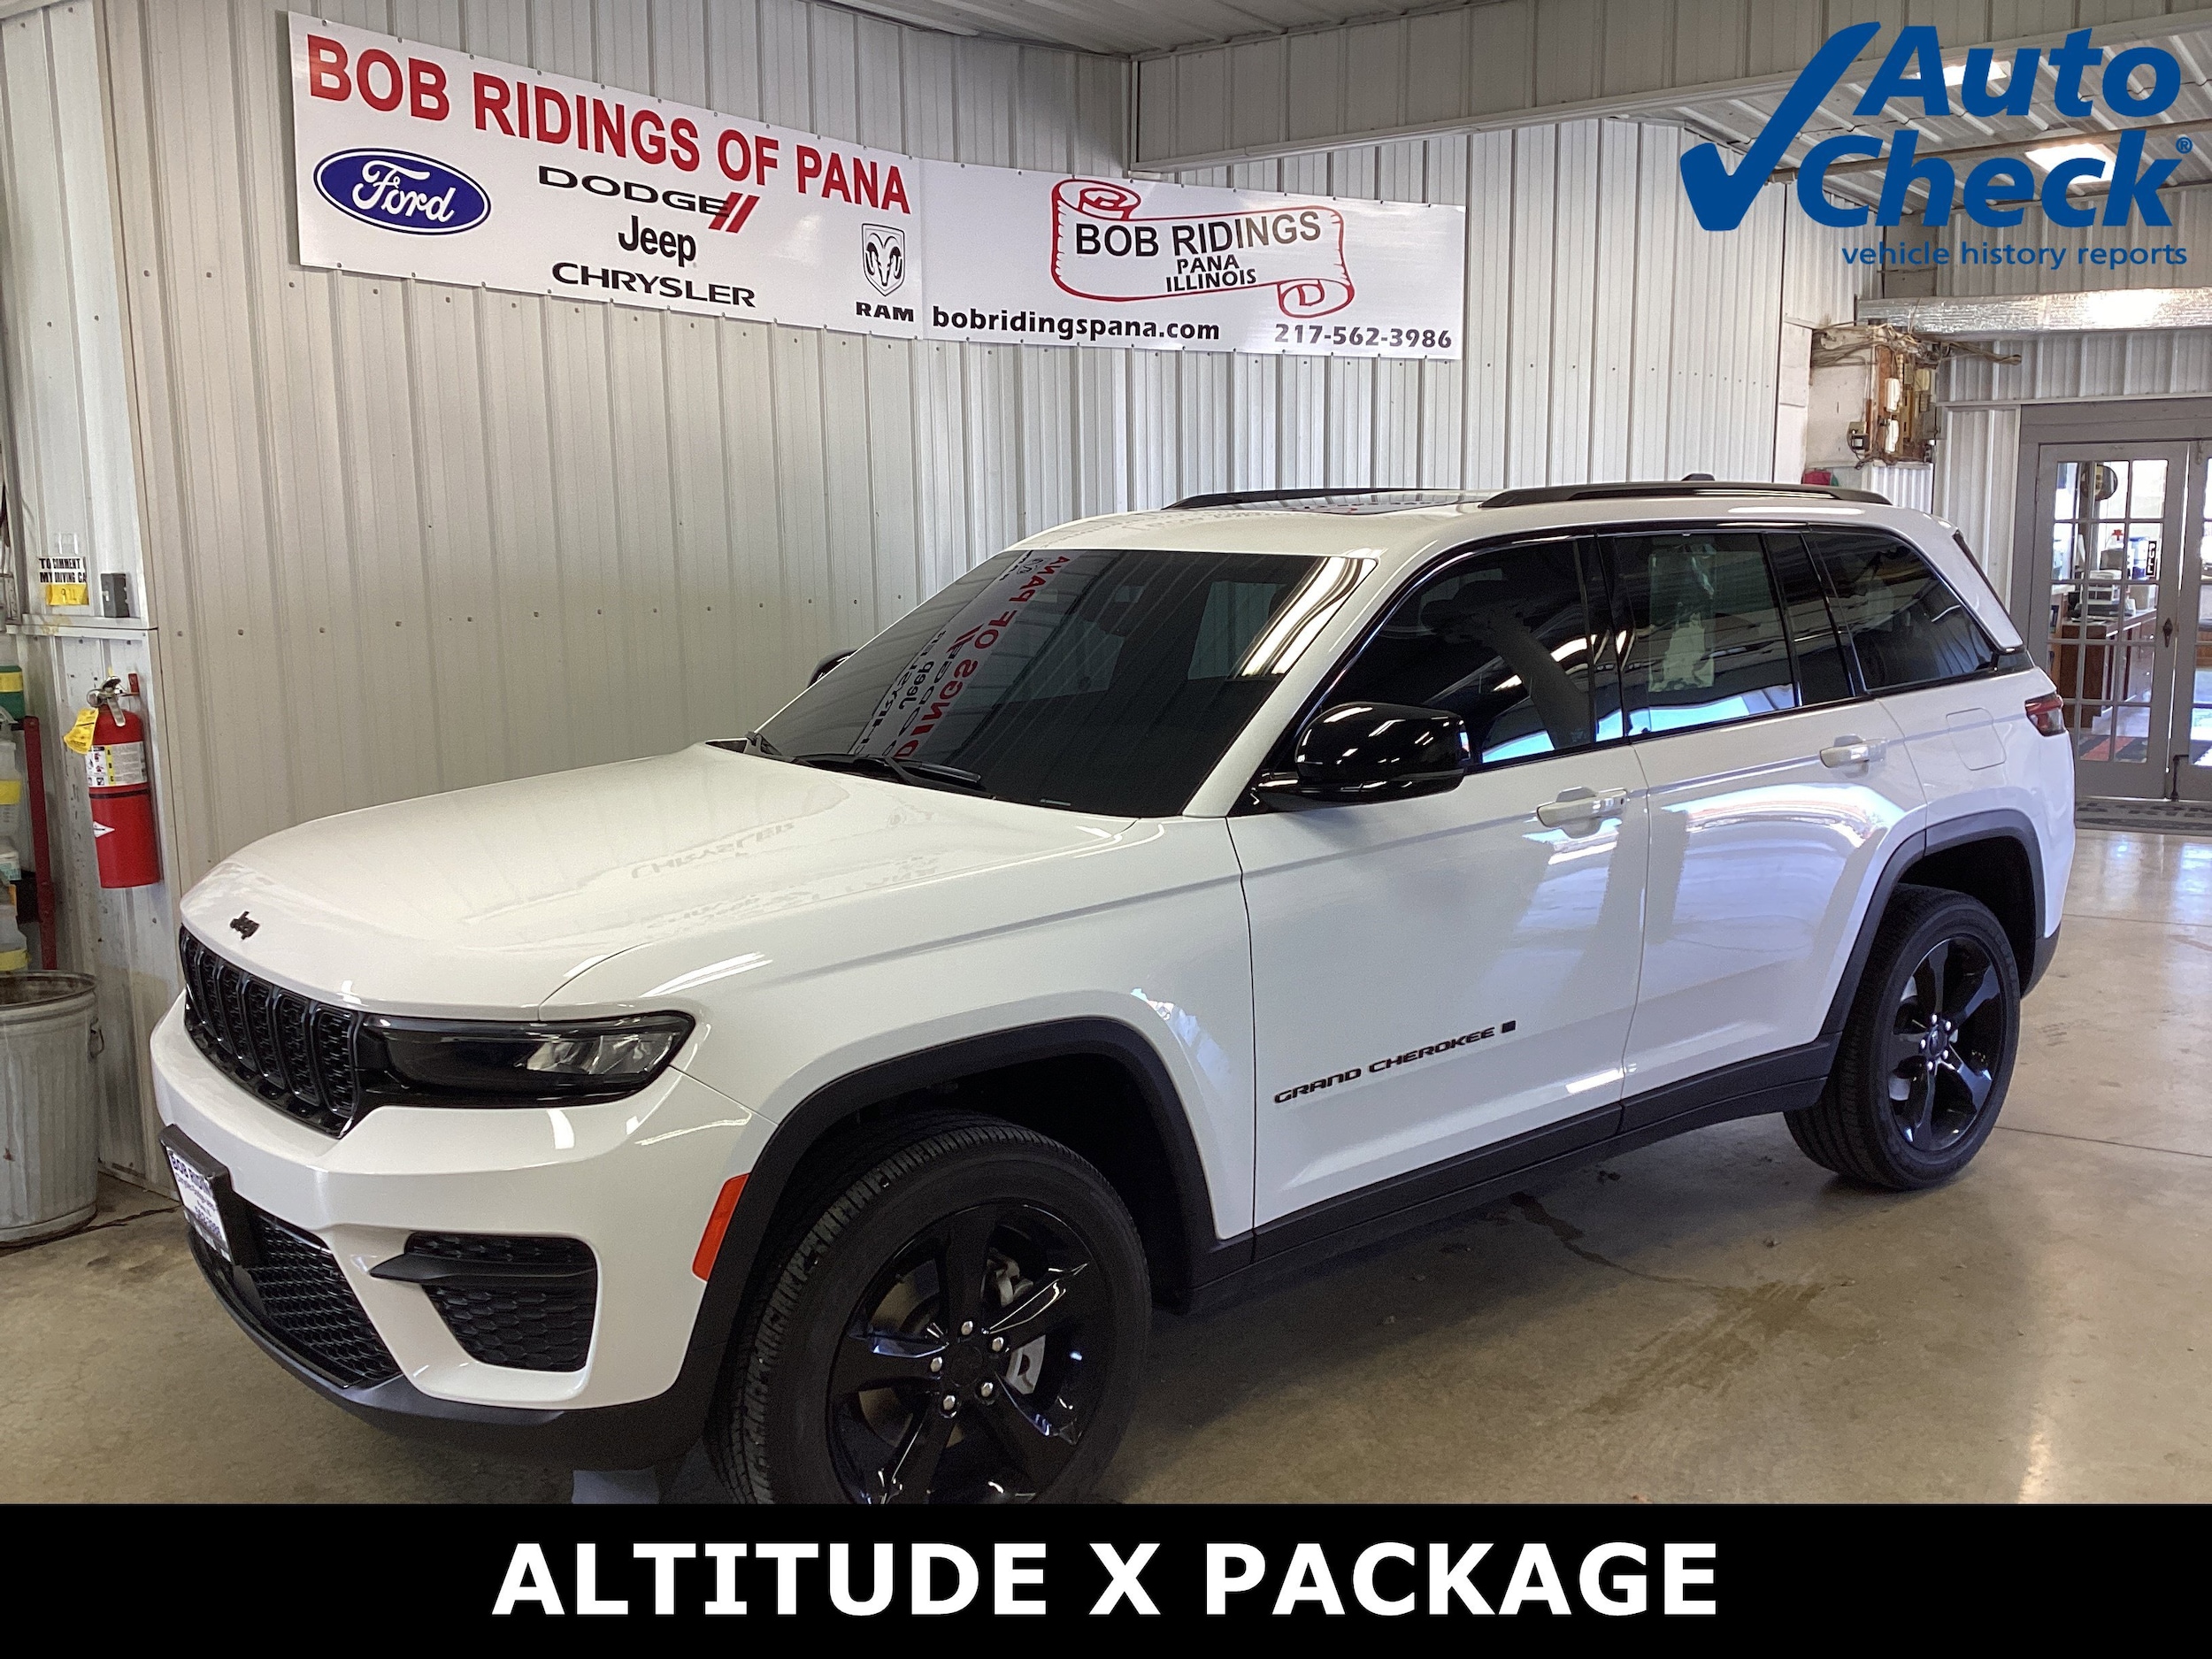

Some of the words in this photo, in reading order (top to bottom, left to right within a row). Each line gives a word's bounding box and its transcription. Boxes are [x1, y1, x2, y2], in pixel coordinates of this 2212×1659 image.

[307, 34, 449, 121] BOB
[473, 72, 699, 172] RIDINGS
[718, 128, 780, 187] OF
[796, 144, 910, 215] PANA
[352, 160, 455, 223] Ford
[538, 165, 729, 217] DODGE
[618, 215, 696, 266] Jeep
[1076, 222, 1159, 257] BOB
[1172, 211, 1322, 256] RIDINGS
[1165, 268, 1257, 293] ILLINOIS
[1177, 254, 1240, 275] PANA
[552, 262, 756, 308] CHRYSLER
[856, 302, 914, 322] RAM
[932, 306, 1221, 342] bobridingspana.com
[1274, 323, 1453, 349] 217-562-3986
[39, 558, 51, 569] TO
[2147, 543, 2156, 574] PULL
[40, 572, 53, 583] MY
[1274, 1068, 1362, 1103] GRAND
[1369, 1027, 1495, 1072] CHEROKEE
